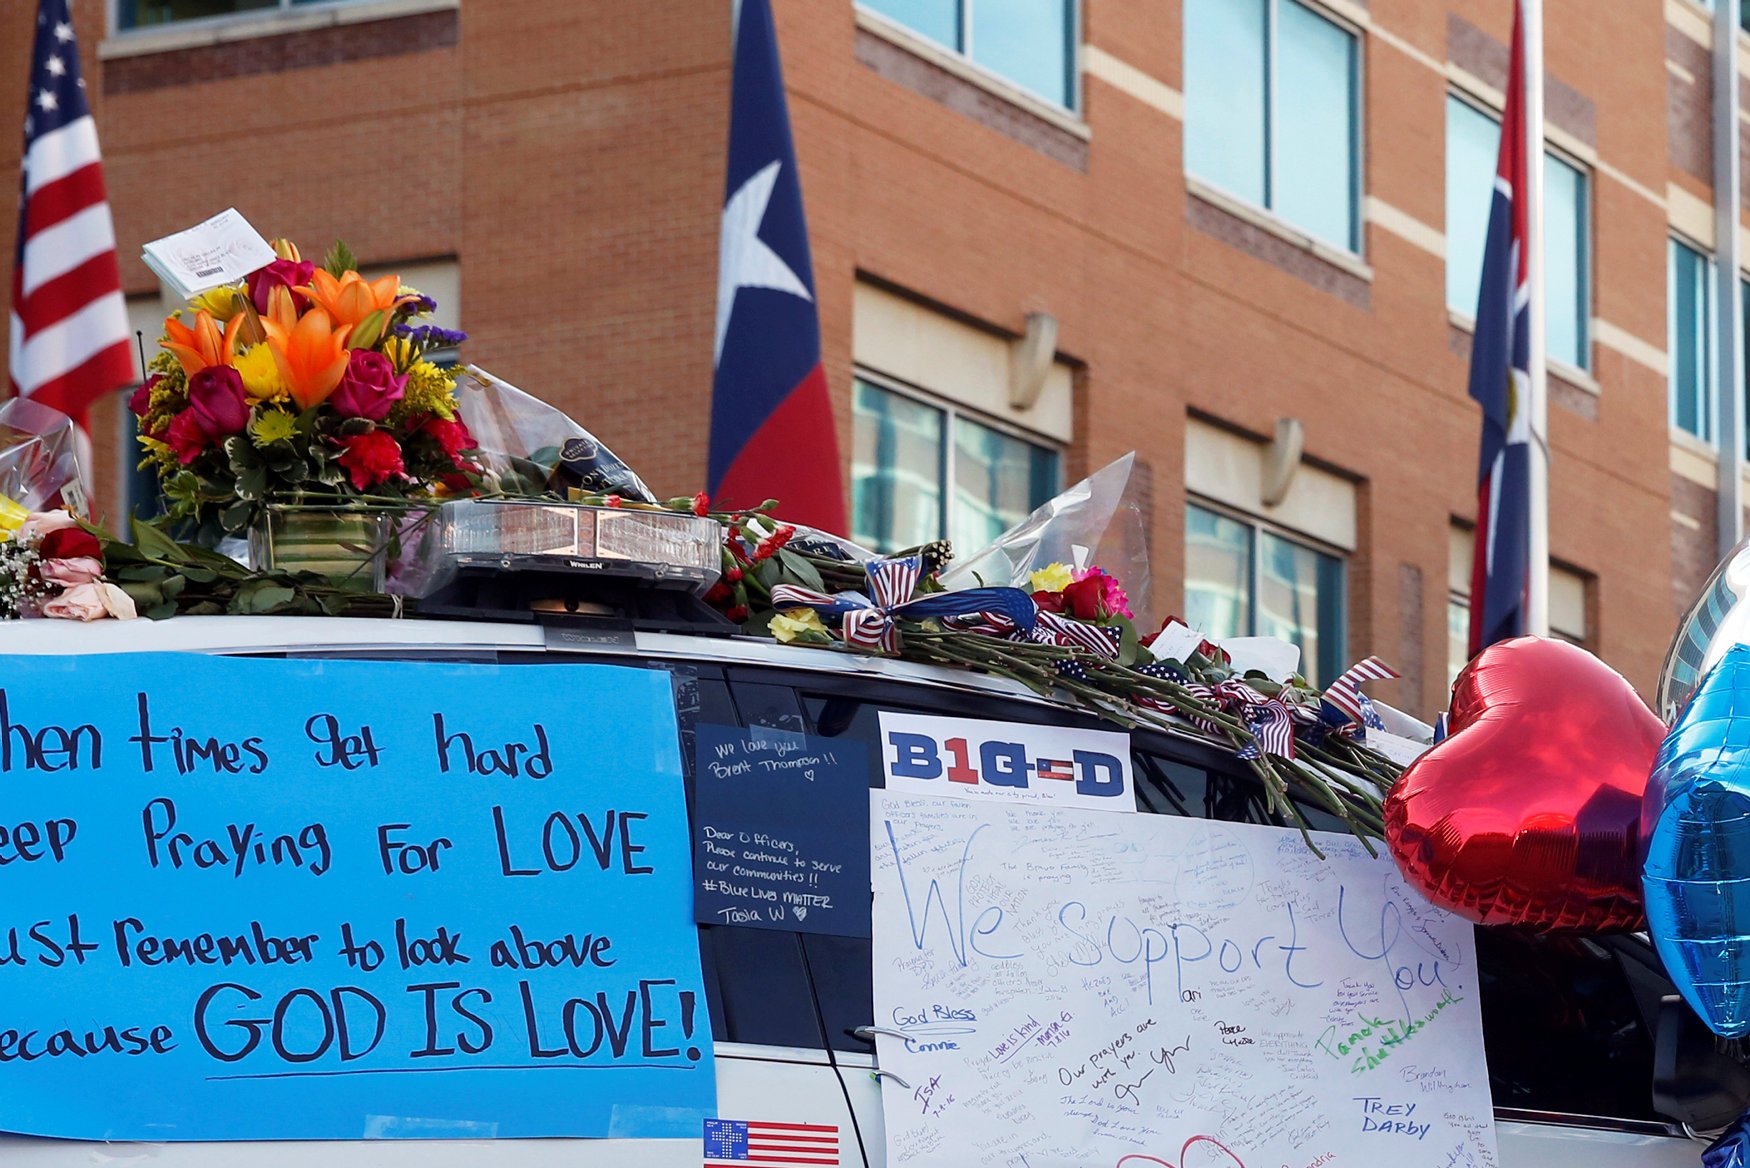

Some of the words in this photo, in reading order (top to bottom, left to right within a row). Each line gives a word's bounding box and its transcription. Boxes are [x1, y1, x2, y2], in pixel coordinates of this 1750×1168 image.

[0, 689, 102, 773] hen
[129, 692, 268, 776] times
[305, 713, 386, 769] get
[433, 713, 554, 779] hard
[715, 743, 734, 759] We
[741, 739, 768, 754] love
[774, 741, 799, 757] you
[708, 759, 752, 779] Brent
[0, 817, 77, 864] eep
[492, 806, 655, 877] LOVE
[703, 826, 735, 841] Dear
[702, 841, 736, 858] Please
[742, 851, 789, 866] continue
[793, 857, 806, 869] to
[811, 861, 843, 875] serve
[706, 860, 730, 872] our
[885, 819, 1026, 970] We
[769, 905, 785, 922] W
[0, 913, 97, 968] ust
[340, 922, 384, 972] to
[393, 918, 471, 971] look
[490, 925, 618, 968] above
[0, 1020, 179, 1061] ecause
[193, 983, 386, 1063] GOD
[405, 981, 493, 1058] IS
[518, 979, 702, 1062] LOVE!
[892, 1006, 929, 1027] God
[932, 1004, 977, 1022] Bless
[1014, 1014, 1042, 1039] kind
[904, 1037, 961, 1054] Connie
[1058, 1062, 1087, 1087] Our
[1090, 1033, 1133, 1070] prayers
[1136, 1018, 1158, 1034] are
[1091, 1070, 1117, 1090] with
[1400, 1064, 1448, 1083] Brandon
[1352, 1097, 1417, 1117] TREY
